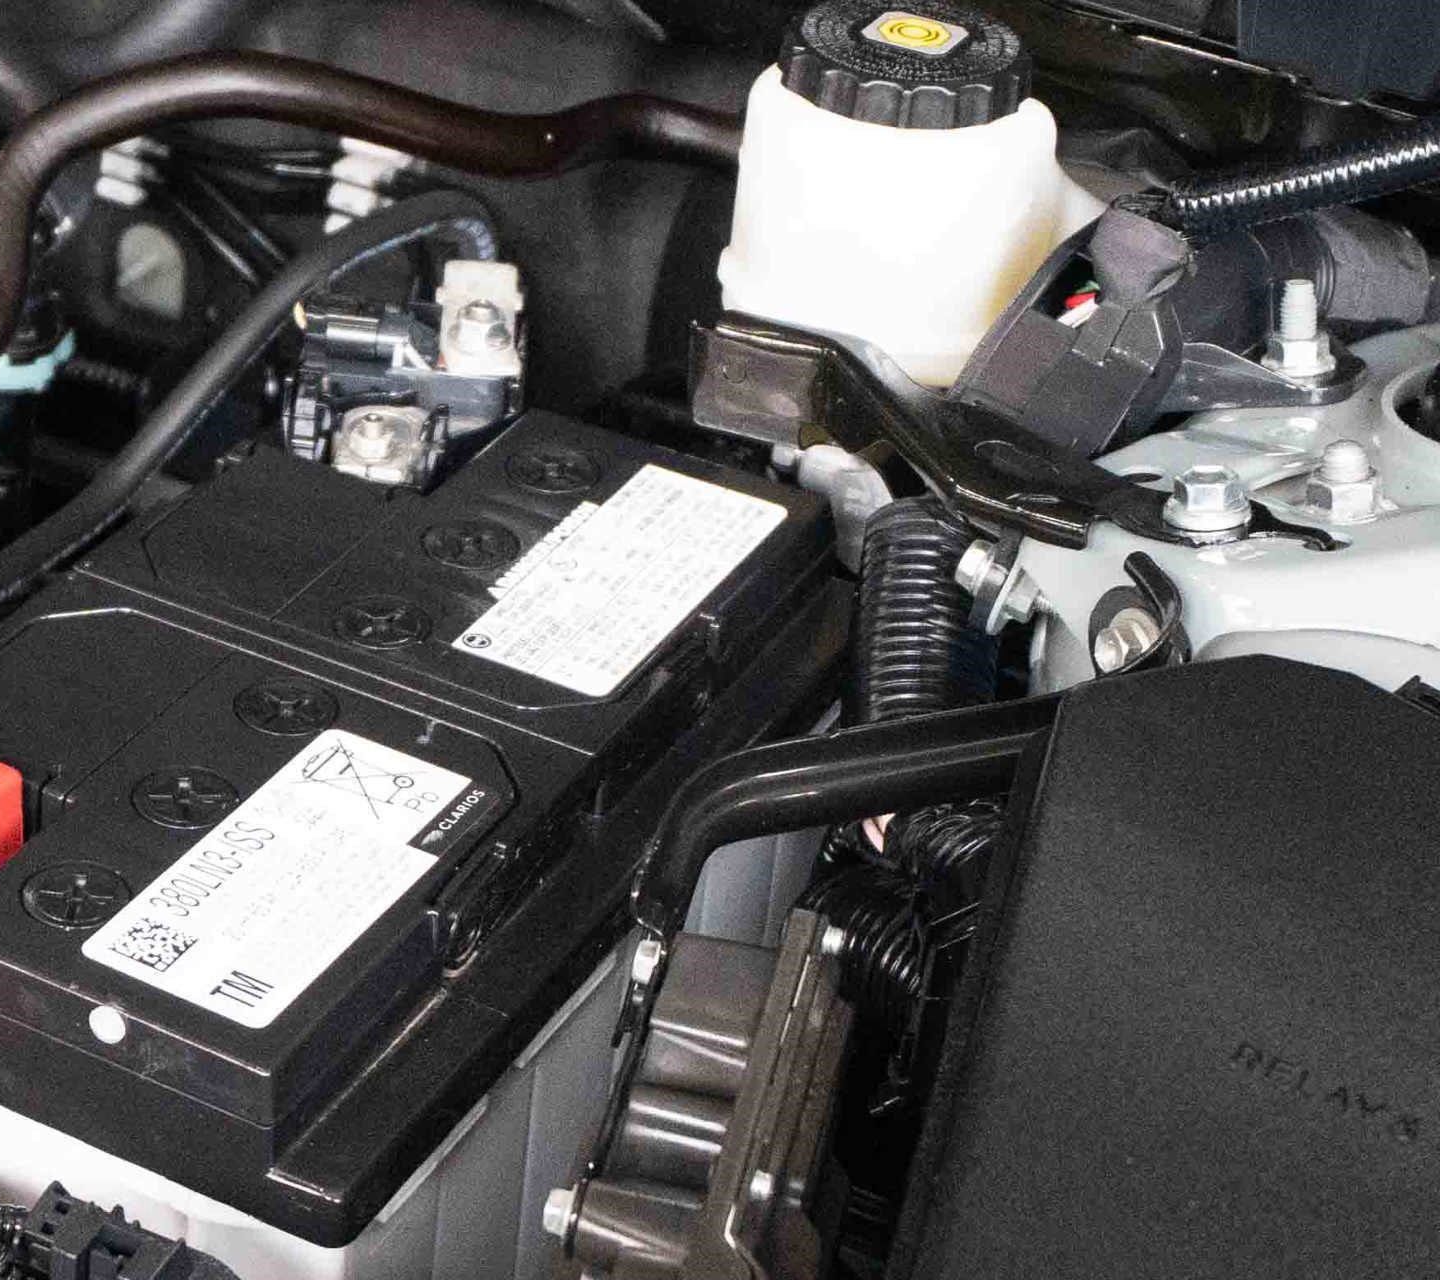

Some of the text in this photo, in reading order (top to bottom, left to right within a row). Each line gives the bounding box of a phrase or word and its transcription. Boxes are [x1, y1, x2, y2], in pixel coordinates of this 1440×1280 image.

[438, 788, 486, 832] CLARIOS
[209, 969, 275, 1009] TM
[1229, 1041, 1389, 1118] RELAY
